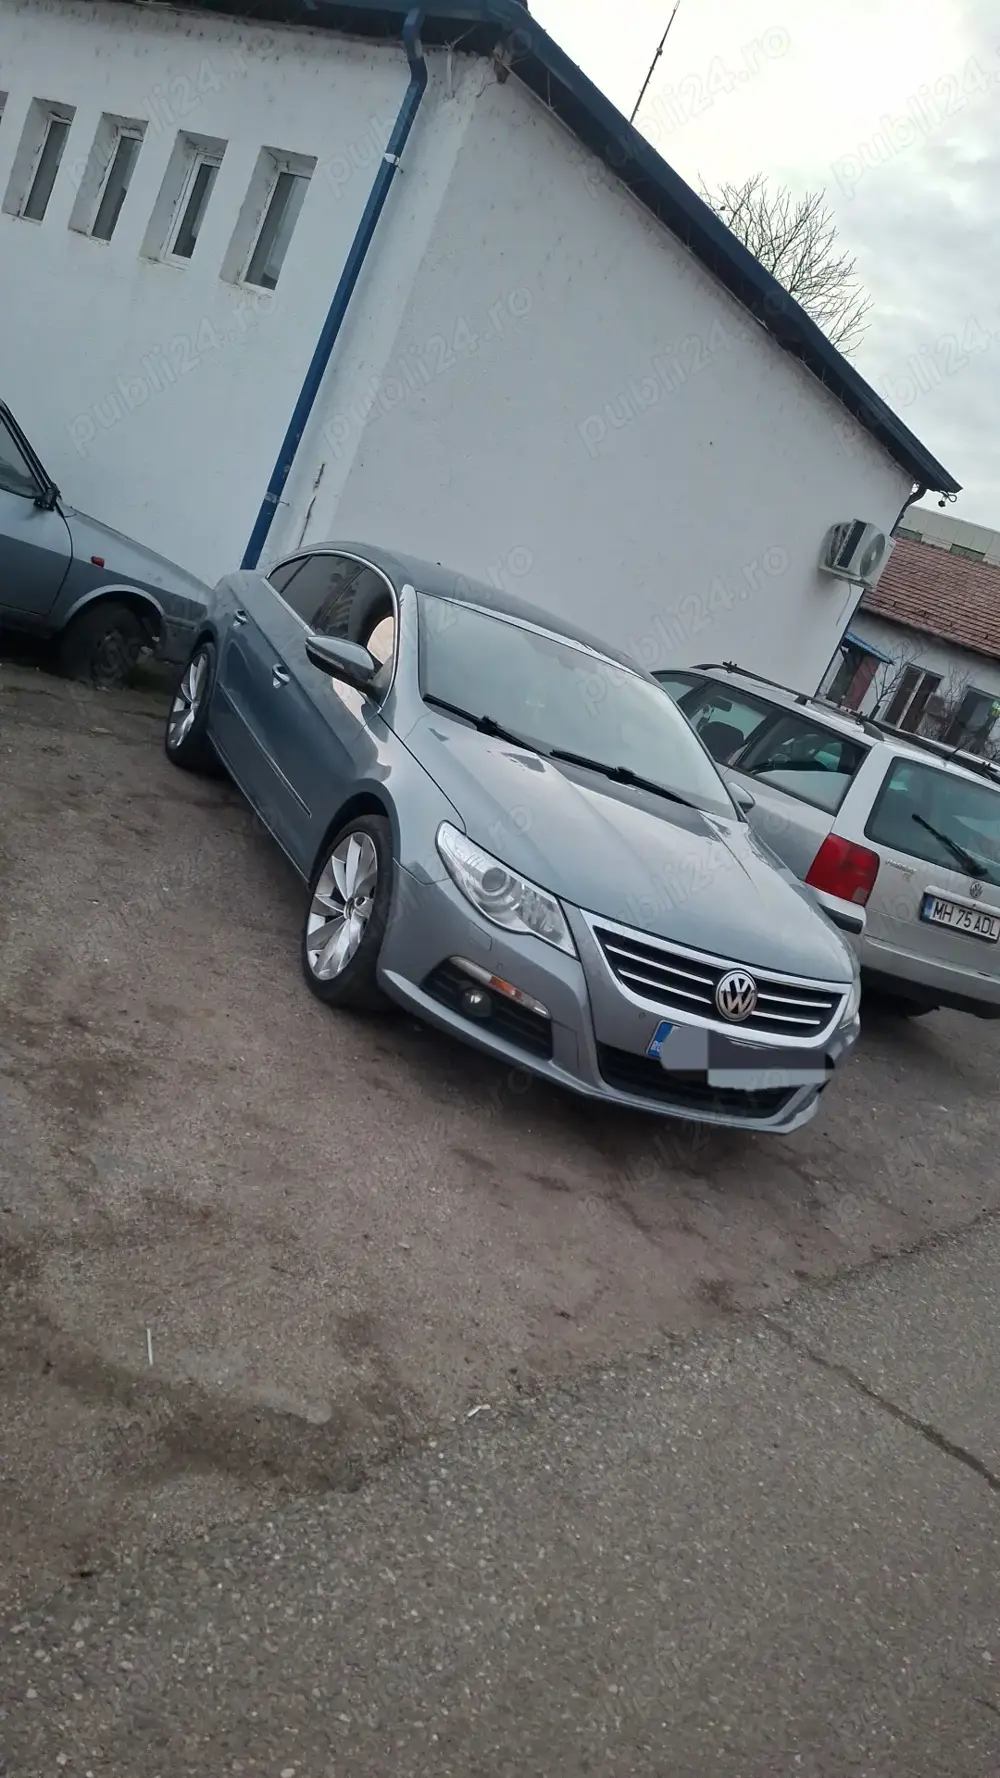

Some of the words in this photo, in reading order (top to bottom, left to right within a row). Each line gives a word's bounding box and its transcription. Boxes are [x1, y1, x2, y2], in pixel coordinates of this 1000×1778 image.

[933, 902, 954, 922] MH
[956, 910, 972, 928] 75
[974, 916, 996, 936] ADL
